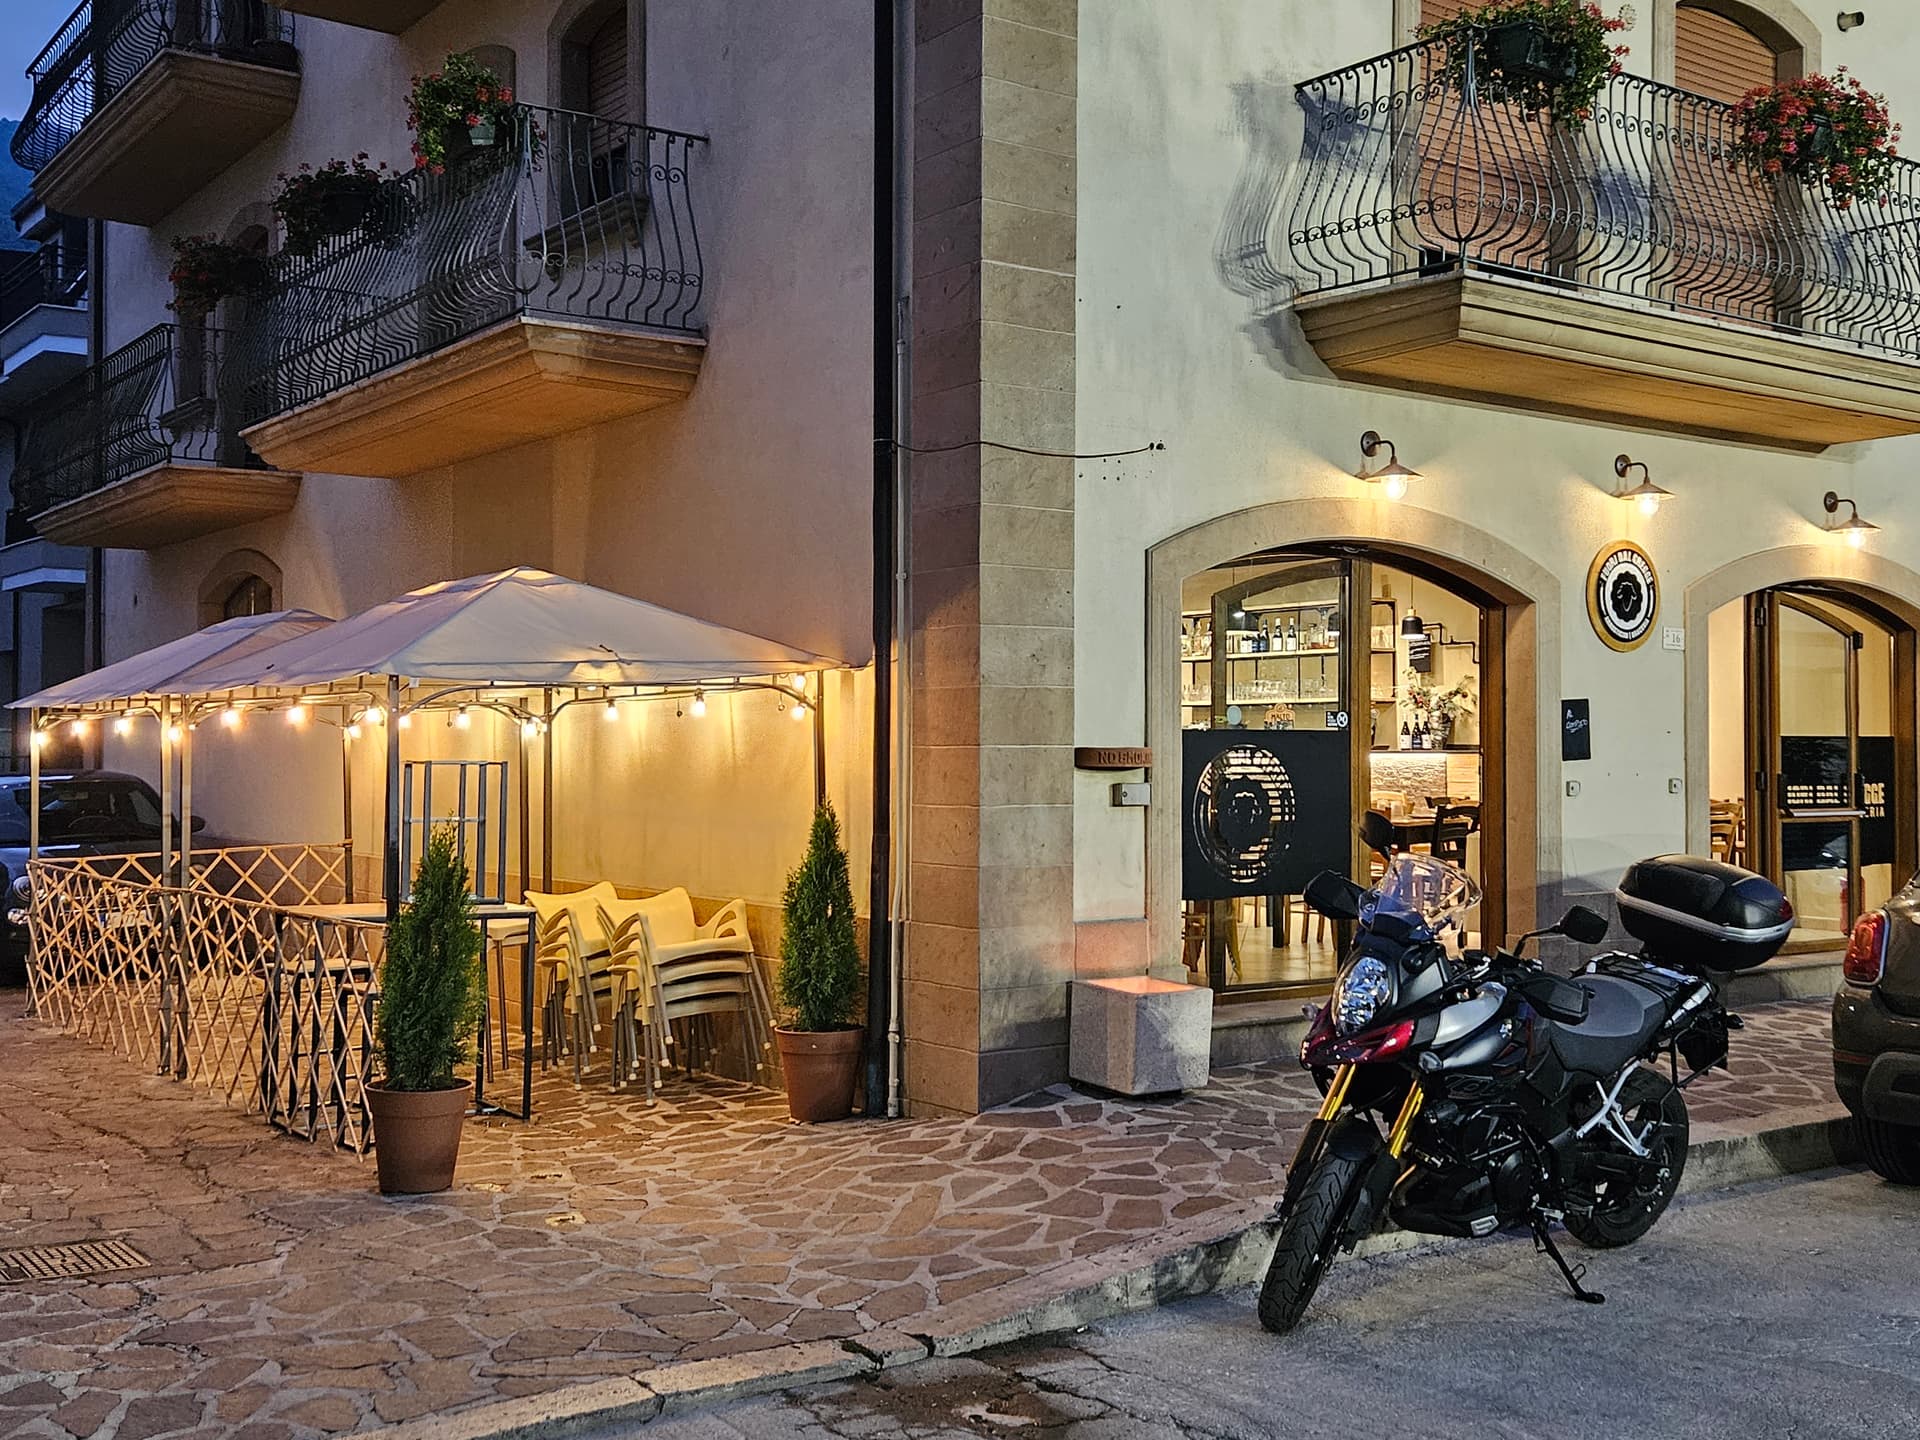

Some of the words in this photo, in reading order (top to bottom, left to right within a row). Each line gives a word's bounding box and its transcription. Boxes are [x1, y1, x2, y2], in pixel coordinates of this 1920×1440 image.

[1672, 633, 1681, 644] 16
[1098, 751, 1116, 765] NO
[1863, 783, 1885, 805] GGE
